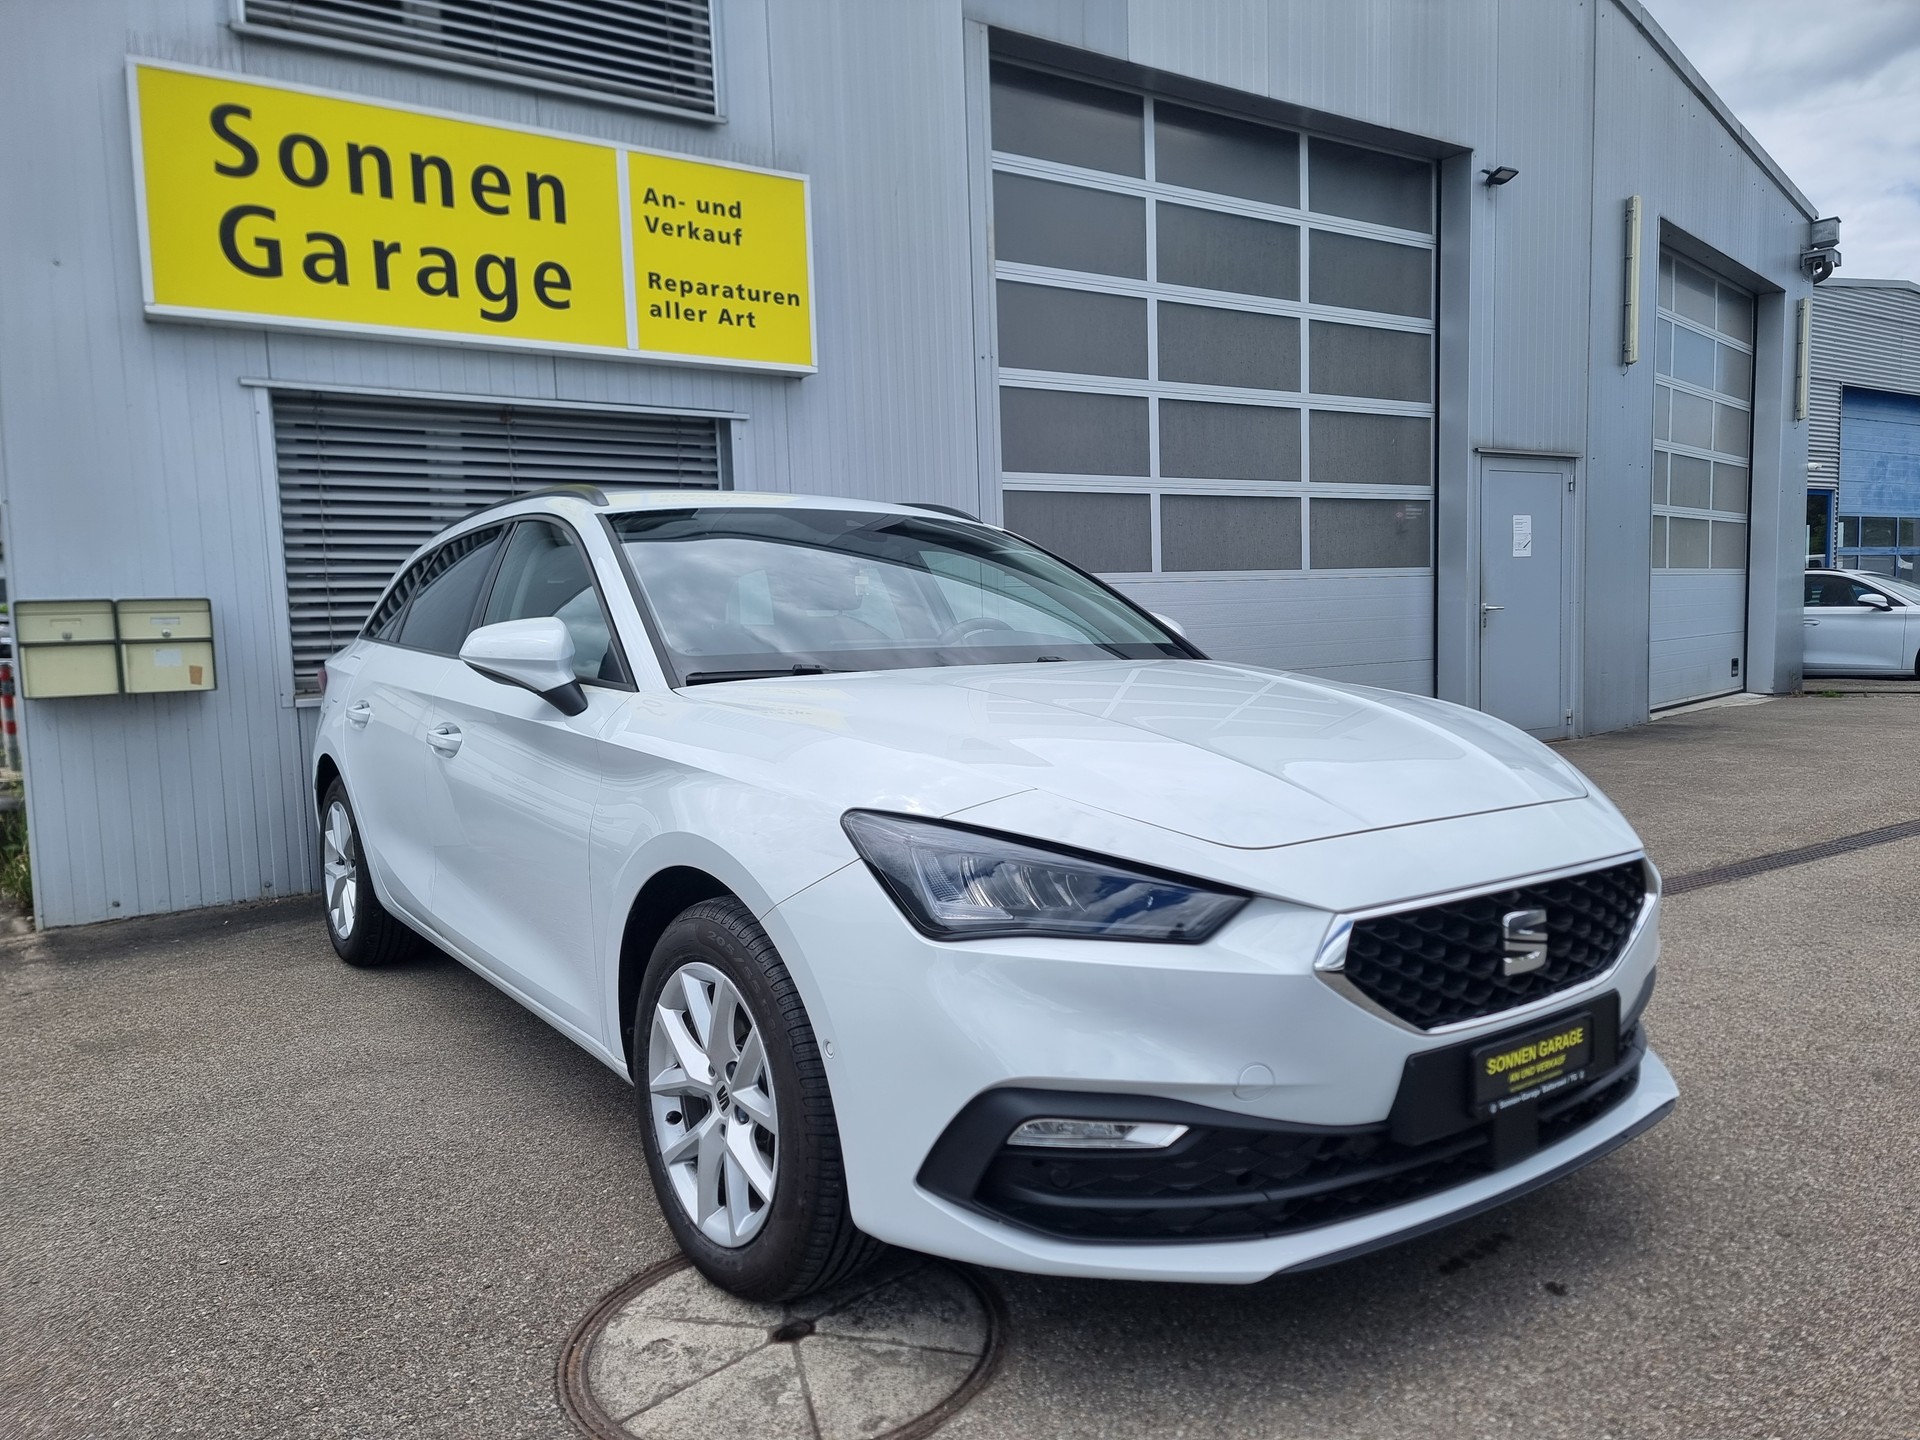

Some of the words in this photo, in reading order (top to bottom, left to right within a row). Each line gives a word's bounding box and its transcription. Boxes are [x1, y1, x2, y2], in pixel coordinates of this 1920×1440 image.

[208, 102, 568, 226] Sonnen
[643, 186, 686, 209] An-
[696, 199, 742, 220] und
[643, 214, 743, 246] Verkauf
[217, 203, 573, 323] Garage
[647, 271, 801, 307] Reparaturen
[649, 300, 708, 323] aller
[717, 308, 757, 329] Art
[1487, 1046, 1537, 1075] SONNEN
[1539, 1028, 1584, 1057] GARAGE
